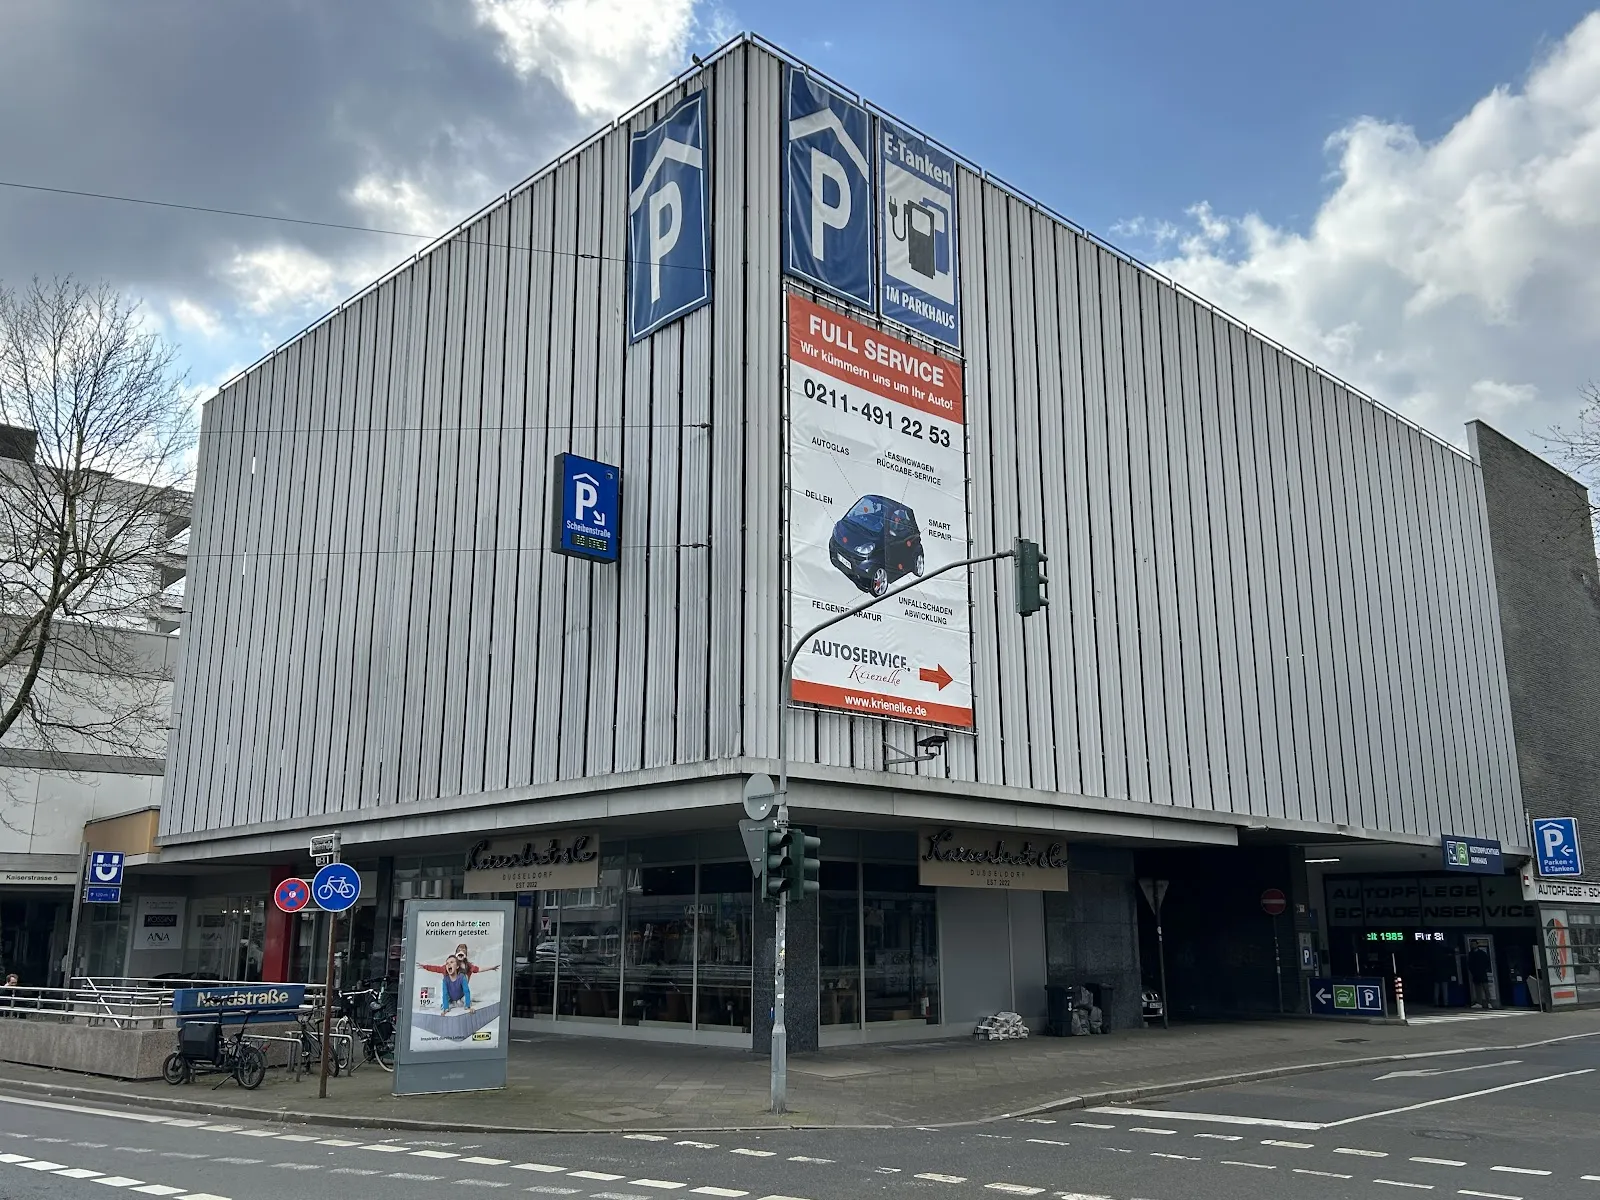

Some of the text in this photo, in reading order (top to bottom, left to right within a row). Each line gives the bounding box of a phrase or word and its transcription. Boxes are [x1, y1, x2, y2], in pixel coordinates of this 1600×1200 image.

[884, 131, 951, 188] E-Tanken
[811, 146, 851, 261] P
[650, 180, 682, 304] P
[886, 285, 955, 330] IM PARKHAUS
[809, 314, 944, 388] FULL SERVICE
[799, 340, 953, 411] Wir kümmern uns um Ihr Auto!
[803, 378, 951, 448] 0211-491 22 53
[811, 436, 850, 456] AUTOGLAS
[884, 450, 935, 473] LEASINGWAGEN
[876, 458, 942, 486] RÜCKGABE-SERVICE
[575, 480, 598, 520] P
[805, 489, 833, 505] DELLEN
[566, 520, 611, 539] Scheibenstraße
[929, 518, 951, 531] SMART
[929, 529, 952, 542] REPAIR
[812, 600, 882, 622] FELGENRARATUR
[898, 596, 953, 616] UNFALLSCHADEN
[904, 609, 948, 625] ABWICKLUNG
[844, 694, 927, 716] www.krienelke.de
[1543, 829, 1563, 858] P
[1545, 865, 1575, 873] E-Tanken
[1332, 885, 1478, 900] AUTOPFLEGE
[1538, 884, 1582, 897] AUTOPFLEGE
[1334, 904, 1536, 919] SCHADENSERVICE
[425, 920, 440, 928] Von
[441, 920, 455, 928] den
[425, 928, 490, 938] Kritikern getestet.
[1380, 932, 1404, 940] 1985
